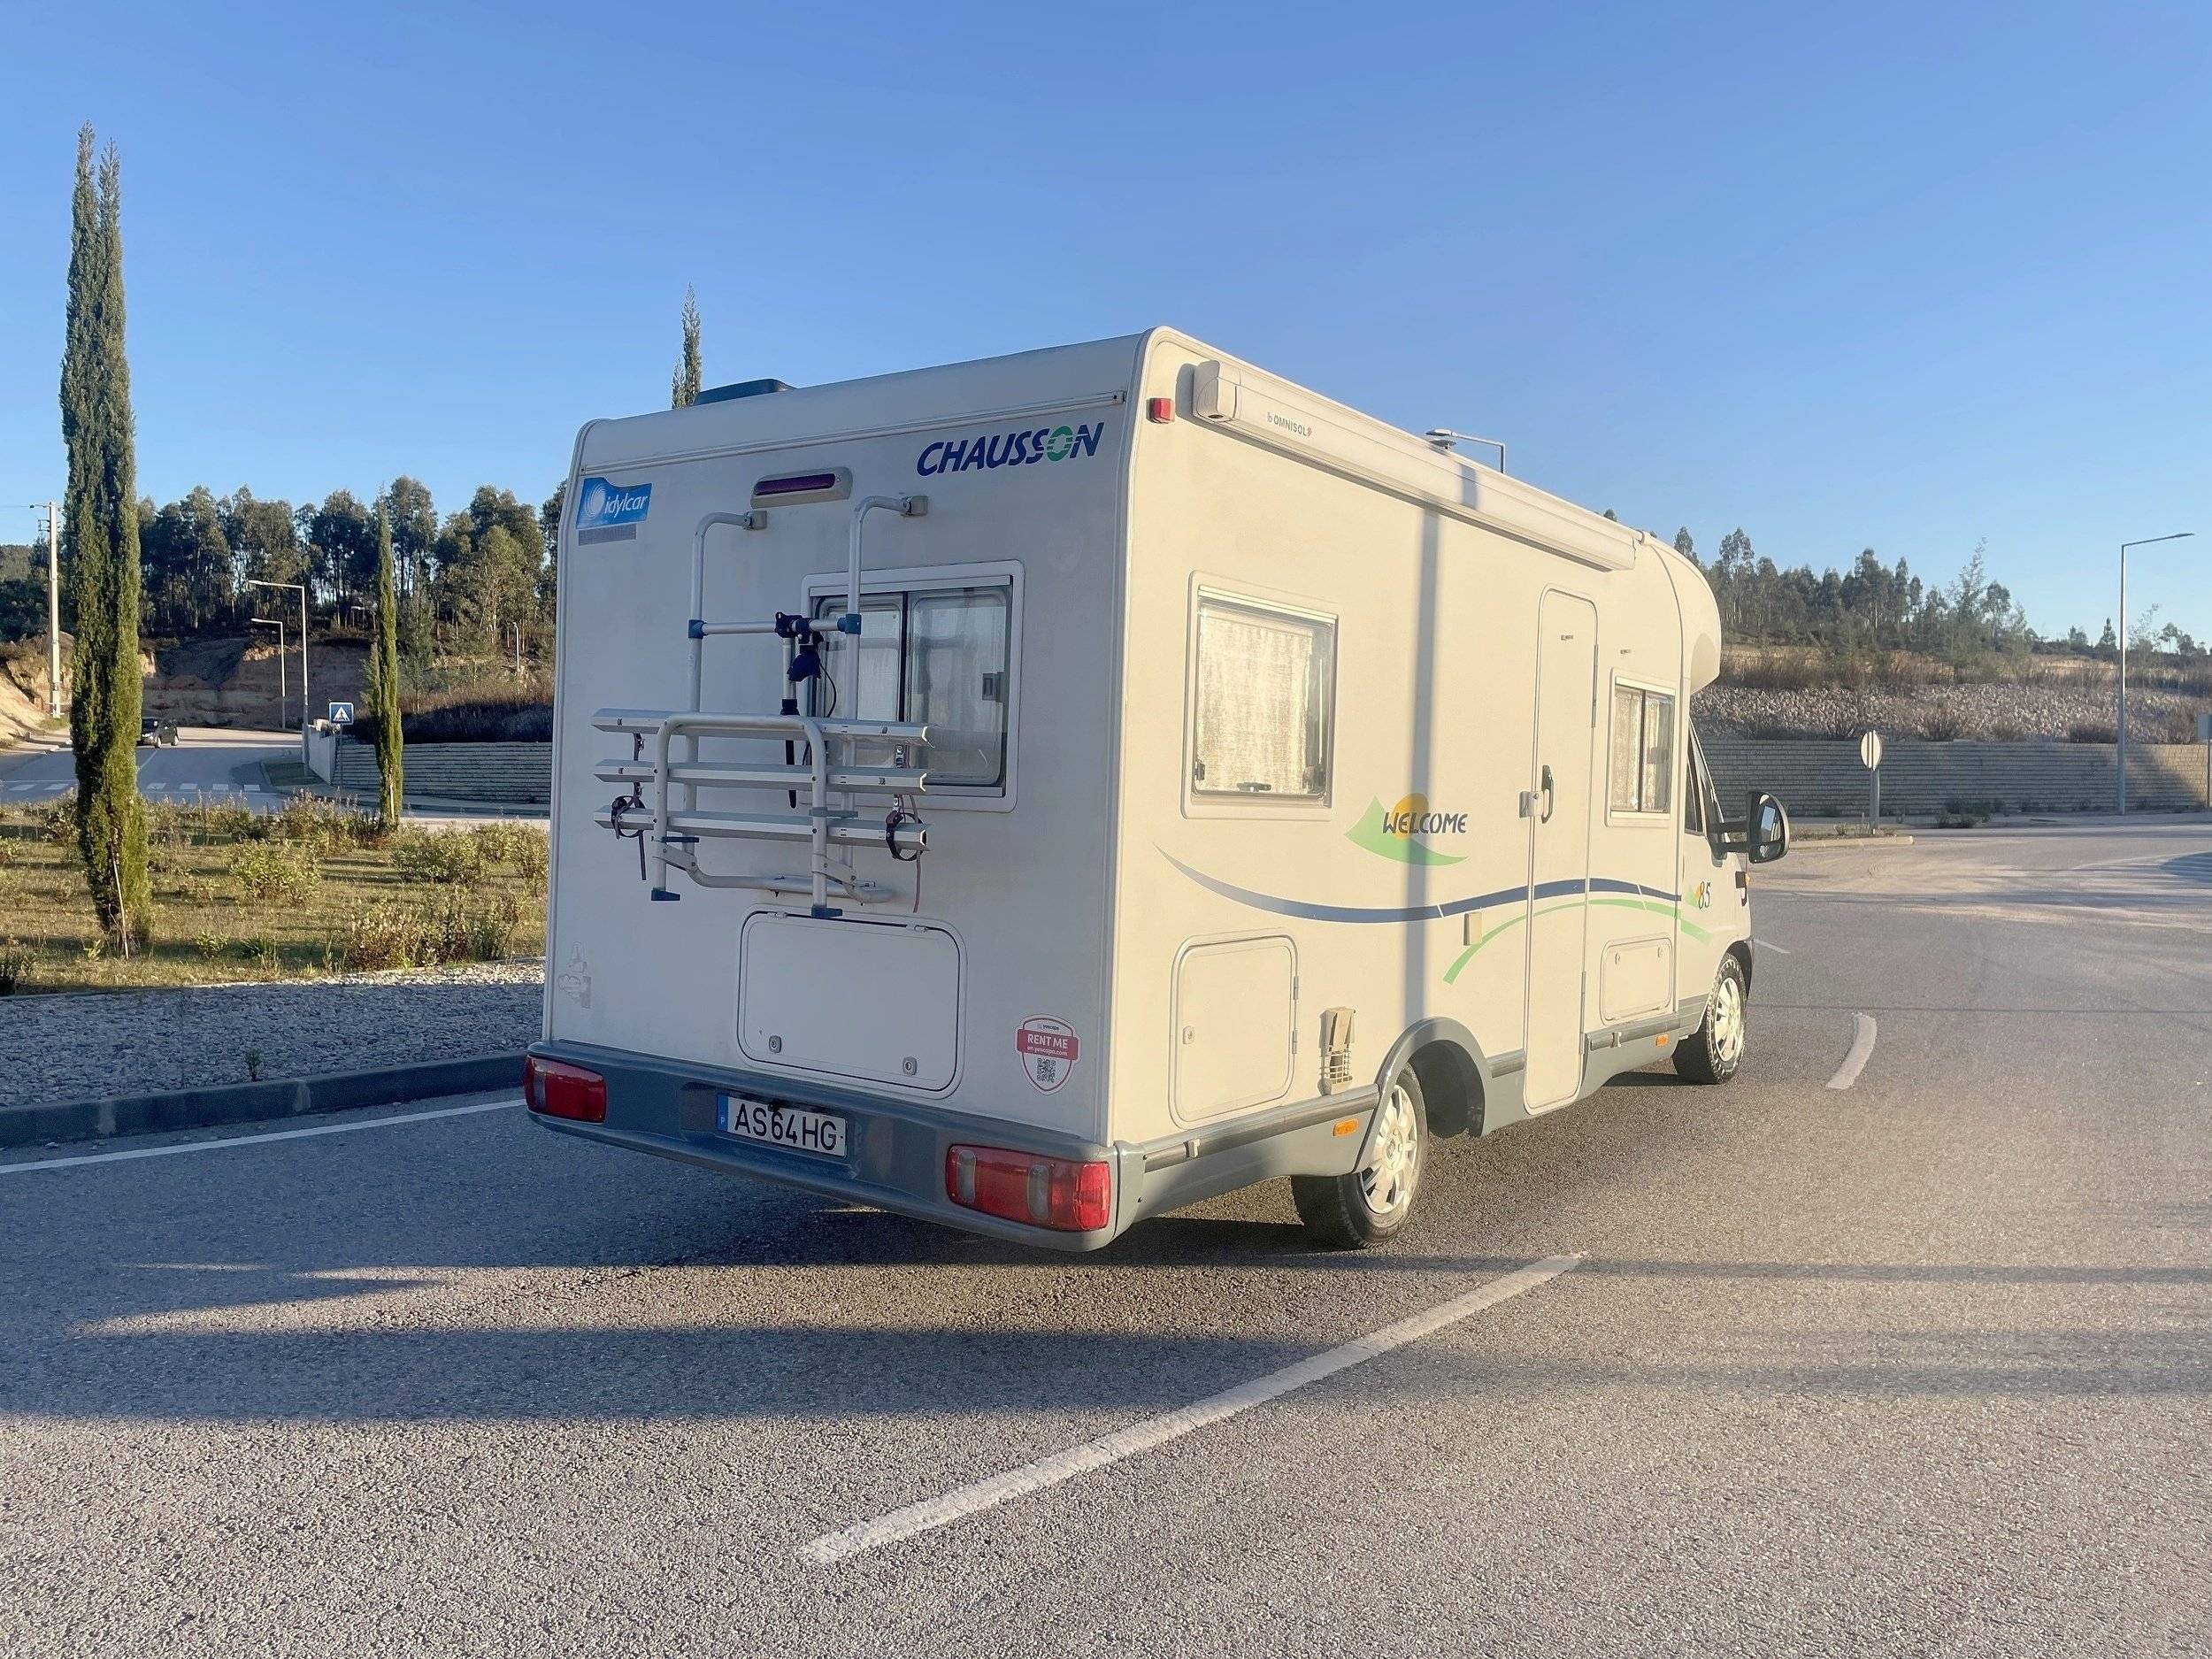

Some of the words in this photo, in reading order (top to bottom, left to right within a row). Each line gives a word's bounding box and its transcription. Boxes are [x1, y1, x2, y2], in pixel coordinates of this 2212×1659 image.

[917, 422, 1104, 476] CHAUSSON
[605, 493, 648, 518] idylcar
[1383, 812, 1468, 834] WELCOME
[1699, 881, 1710, 910] 85
[1027, 1033, 1051, 1047] RENT
[1053, 1037, 1068, 1049] ME
